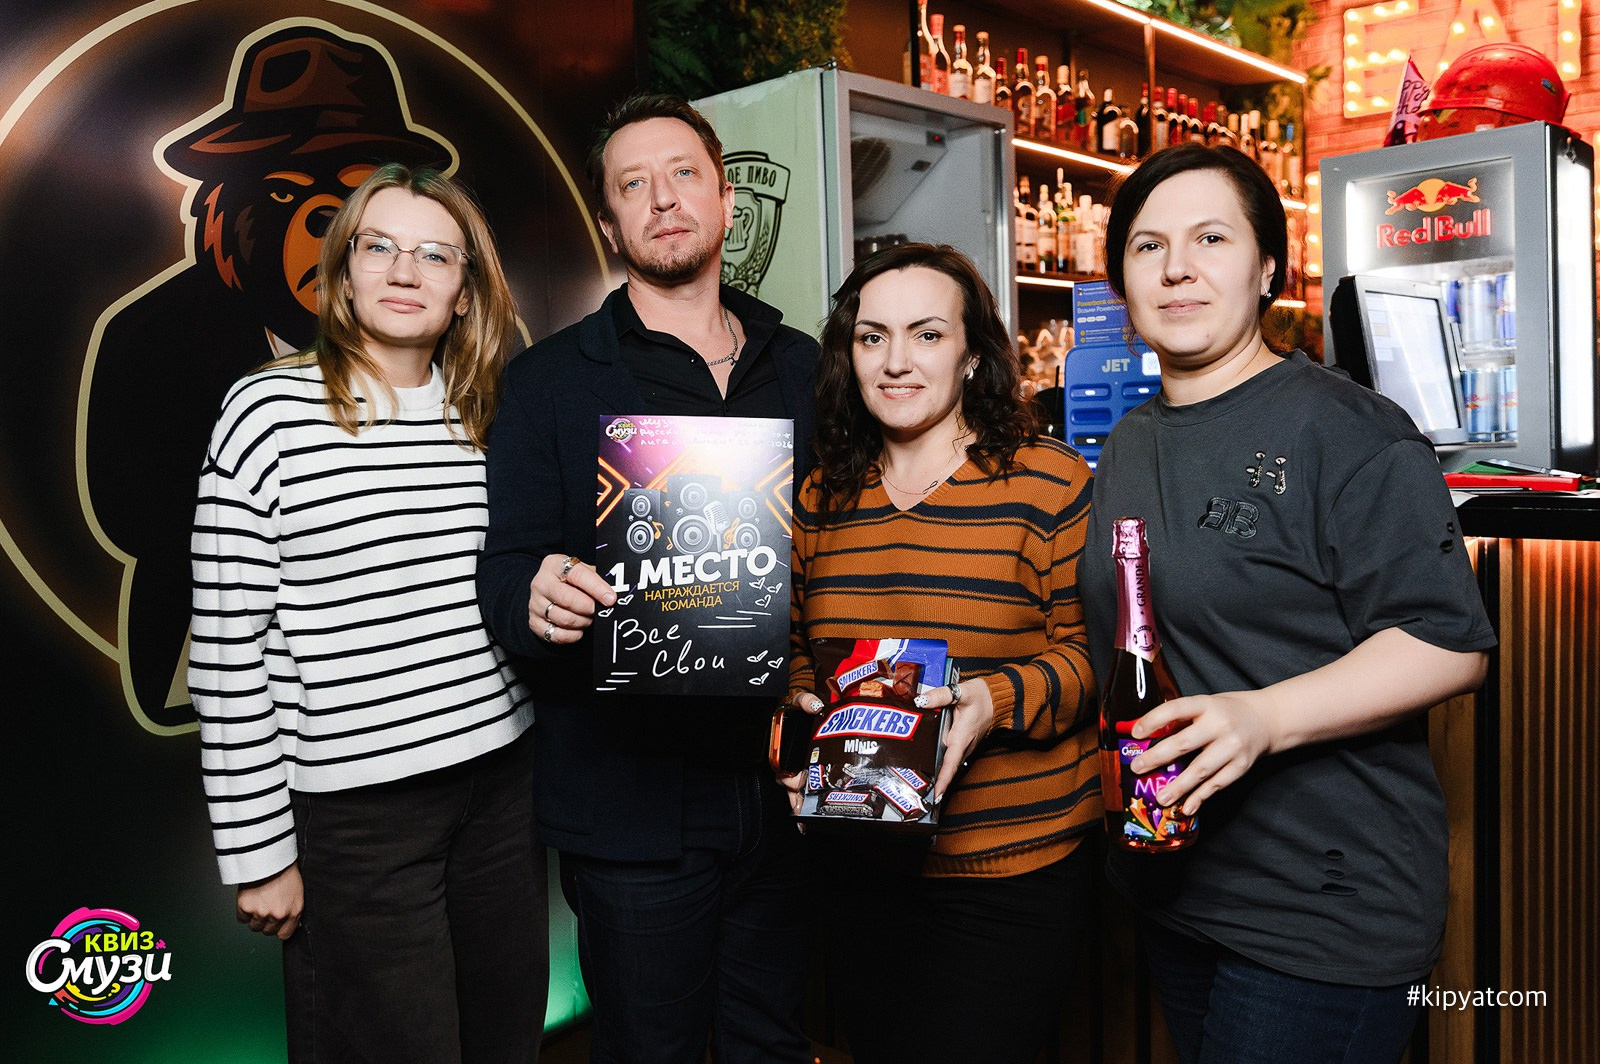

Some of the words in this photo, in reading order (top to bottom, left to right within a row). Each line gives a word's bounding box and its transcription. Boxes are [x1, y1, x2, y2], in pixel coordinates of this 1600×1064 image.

[747, 166, 777, 187] ПИВО
[1376, 216, 1431, 249] Red
[1435, 208, 1492, 242] Bull
[1102, 358, 1130, 373] JET
[605, 424, 638, 437] Смузи
[609, 562, 630, 594] 1
[637, 546, 777, 591] МЕСТО
[644, 581, 740, 602] НАГРАЖДАЕТСЯ
[1135, 563, 1146, 607] GRANDE
[661, 596, 723, 612] КОМАНДА
[612, 618, 681, 663] Все
[652, 640, 725, 678] Свои
[838, 661, 879, 692] SNICKERS
[821, 709, 915, 735] SNICKERS
[844, 739, 879, 755] MINIS
[827, 793, 867, 802] SNICKERS
